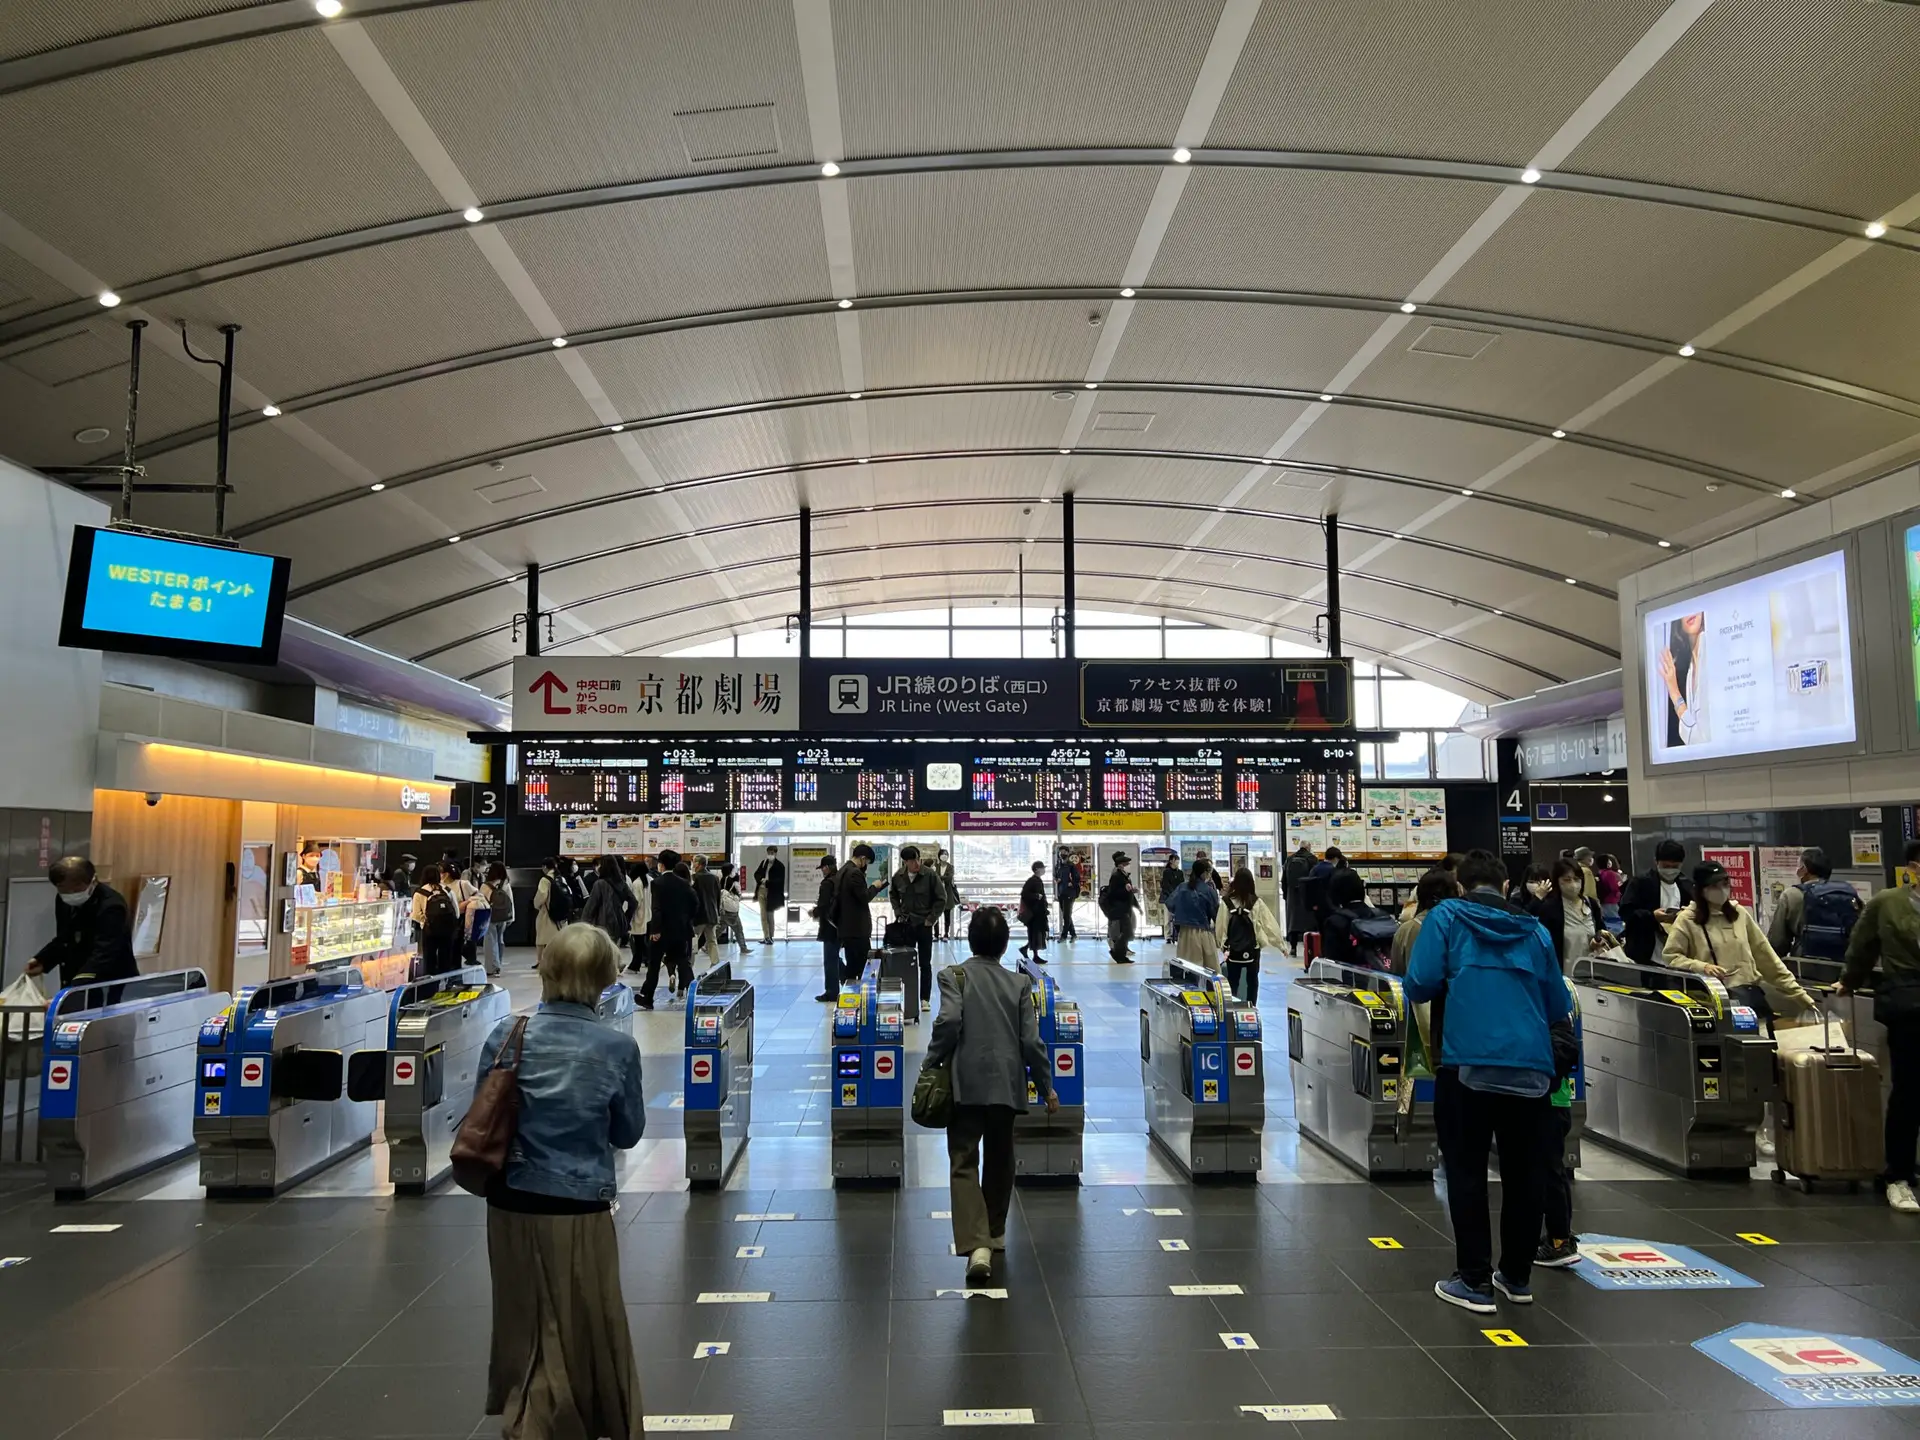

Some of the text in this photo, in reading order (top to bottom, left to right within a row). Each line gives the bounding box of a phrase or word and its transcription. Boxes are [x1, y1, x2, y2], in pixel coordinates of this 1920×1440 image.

[109, 564, 254, 597] WESTERポイント
[150, 591, 211, 612] たまる!
[576, 680, 621, 691] 中央口前
[1129, 677, 1238, 692] アクセス抜群の
[576, 692, 597, 702] から
[636, 673, 781, 714] 京都劇場
[576, 704, 627, 714] 東へ90m
[879, 699, 1028, 714] JR Line (West Gate)
[1097, 698, 1271, 713] 京都劇場で感動を体験!
[537, 750, 560, 758] 31-33
[1115, 749, 1125, 757] 30
[1324, 749, 1344, 758] 8-10
[481, 791, 497, 814] 3
[1506, 789, 1523, 811] 4
[1202, 1053, 1219, 1070] IC
[1803, 1392, 1833, 1401] IC
[1834, 1390, 1892, 1401] Card
